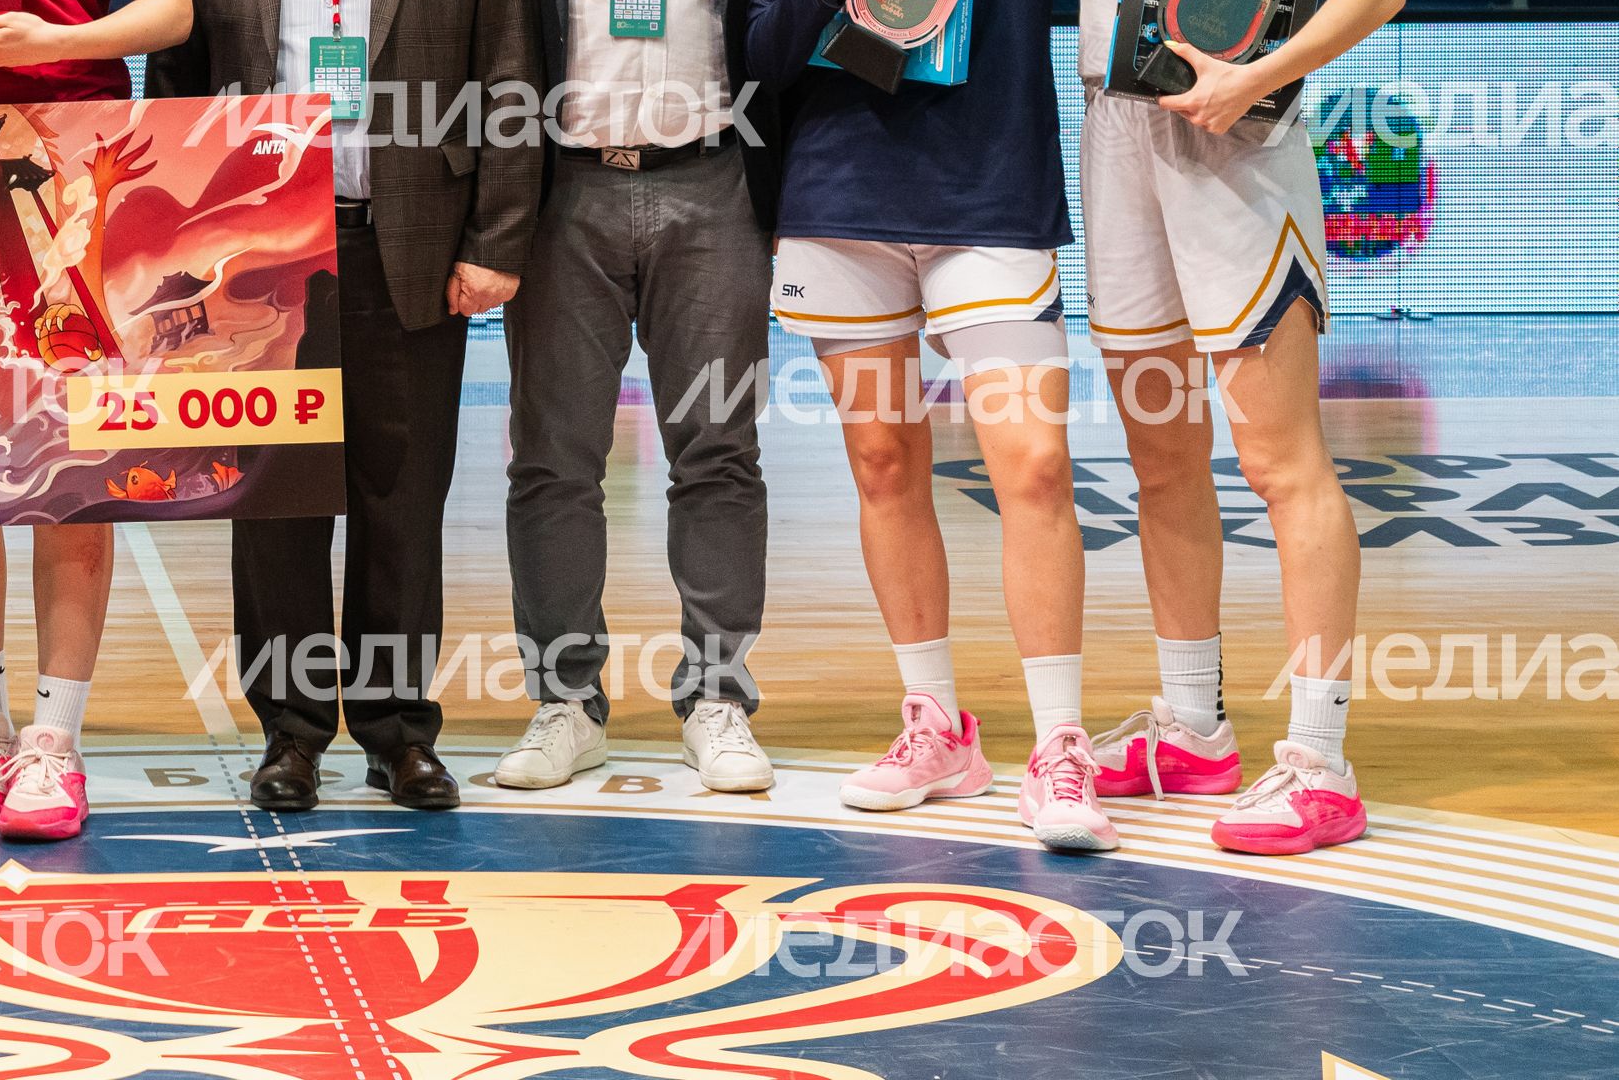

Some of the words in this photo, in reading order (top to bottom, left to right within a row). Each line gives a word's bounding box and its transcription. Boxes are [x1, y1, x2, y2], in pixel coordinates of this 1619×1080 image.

[252, 140, 287, 156] ANTA
[781, 284, 805, 298] STK
[97, 391, 159, 431] 25
[178, 386, 277, 429] 000
